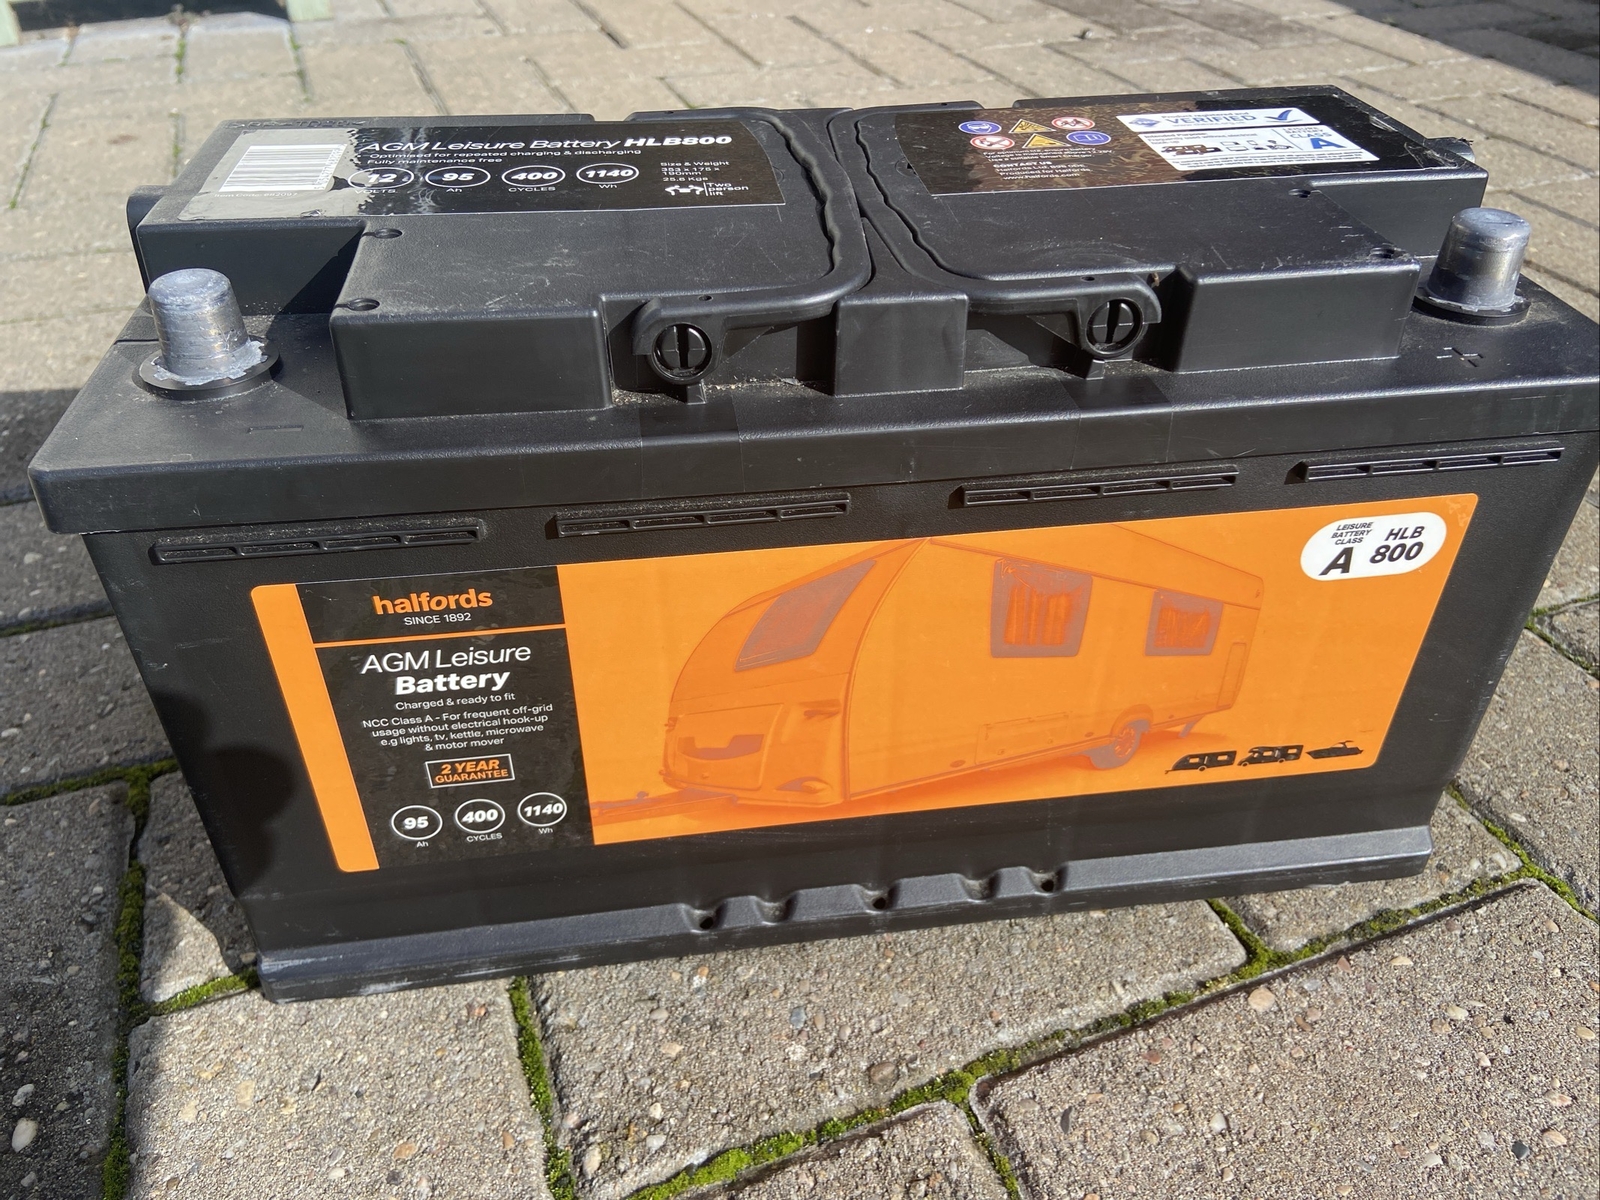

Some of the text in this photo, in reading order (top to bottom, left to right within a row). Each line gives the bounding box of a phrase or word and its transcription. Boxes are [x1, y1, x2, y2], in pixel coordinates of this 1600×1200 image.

[1166, 115, 1256, 124] VERIFIED
[359, 136, 732, 152] AGM Leisure Battery HLB800
[1310, 138, 1347, 149] A
[367, 173, 398, 182] 12
[442, 172, 475, 181] 95
[511, 172, 558, 180] 400
[586, 169, 634, 178] 1140
[1331, 529, 1372, 539] BATTERY
[1336, 522, 1374, 532] LEISURE
[1384, 526, 1425, 542] HLB
[1334, 536, 1364, 546] CLASS
[1318, 546, 1354, 576] A
[1369, 542, 1424, 564] 800
[372, 588, 493, 614] halfords
[404, 612, 472, 626] SINCE 1892
[360, 646, 531, 674] AGM Leisure
[395, 671, 510, 695] Battery
[395, 699, 444, 710] Charged
[456, 696, 488, 706] ready
[490, 694, 502, 702] to
[504, 692, 516, 700] fit
[362, 718, 389, 728] NCC
[392, 715, 422, 726] Class
[424, 714, 434, 722] A
[442, 713, 460, 721] For
[463, 708, 510, 720] frequent
[512, 704, 553, 714] off-grid
[372, 714, 548, 738] usage without electrical hook-up
[380, 724, 544, 746] e.g lights, tv, kettle, microwave
[435, 741, 468, 750] motor
[470, 738, 504, 747] mover
[440, 758, 500, 774] 2 YEAR
[434, 768, 509, 784] GUARANTEE
[462, 808, 498, 824] 400
[524, 802, 564, 818] 1140
[404, 816, 429, 830] 95
[538, 827, 554, 835] Wh
[466, 832, 503, 843] CYCLES
